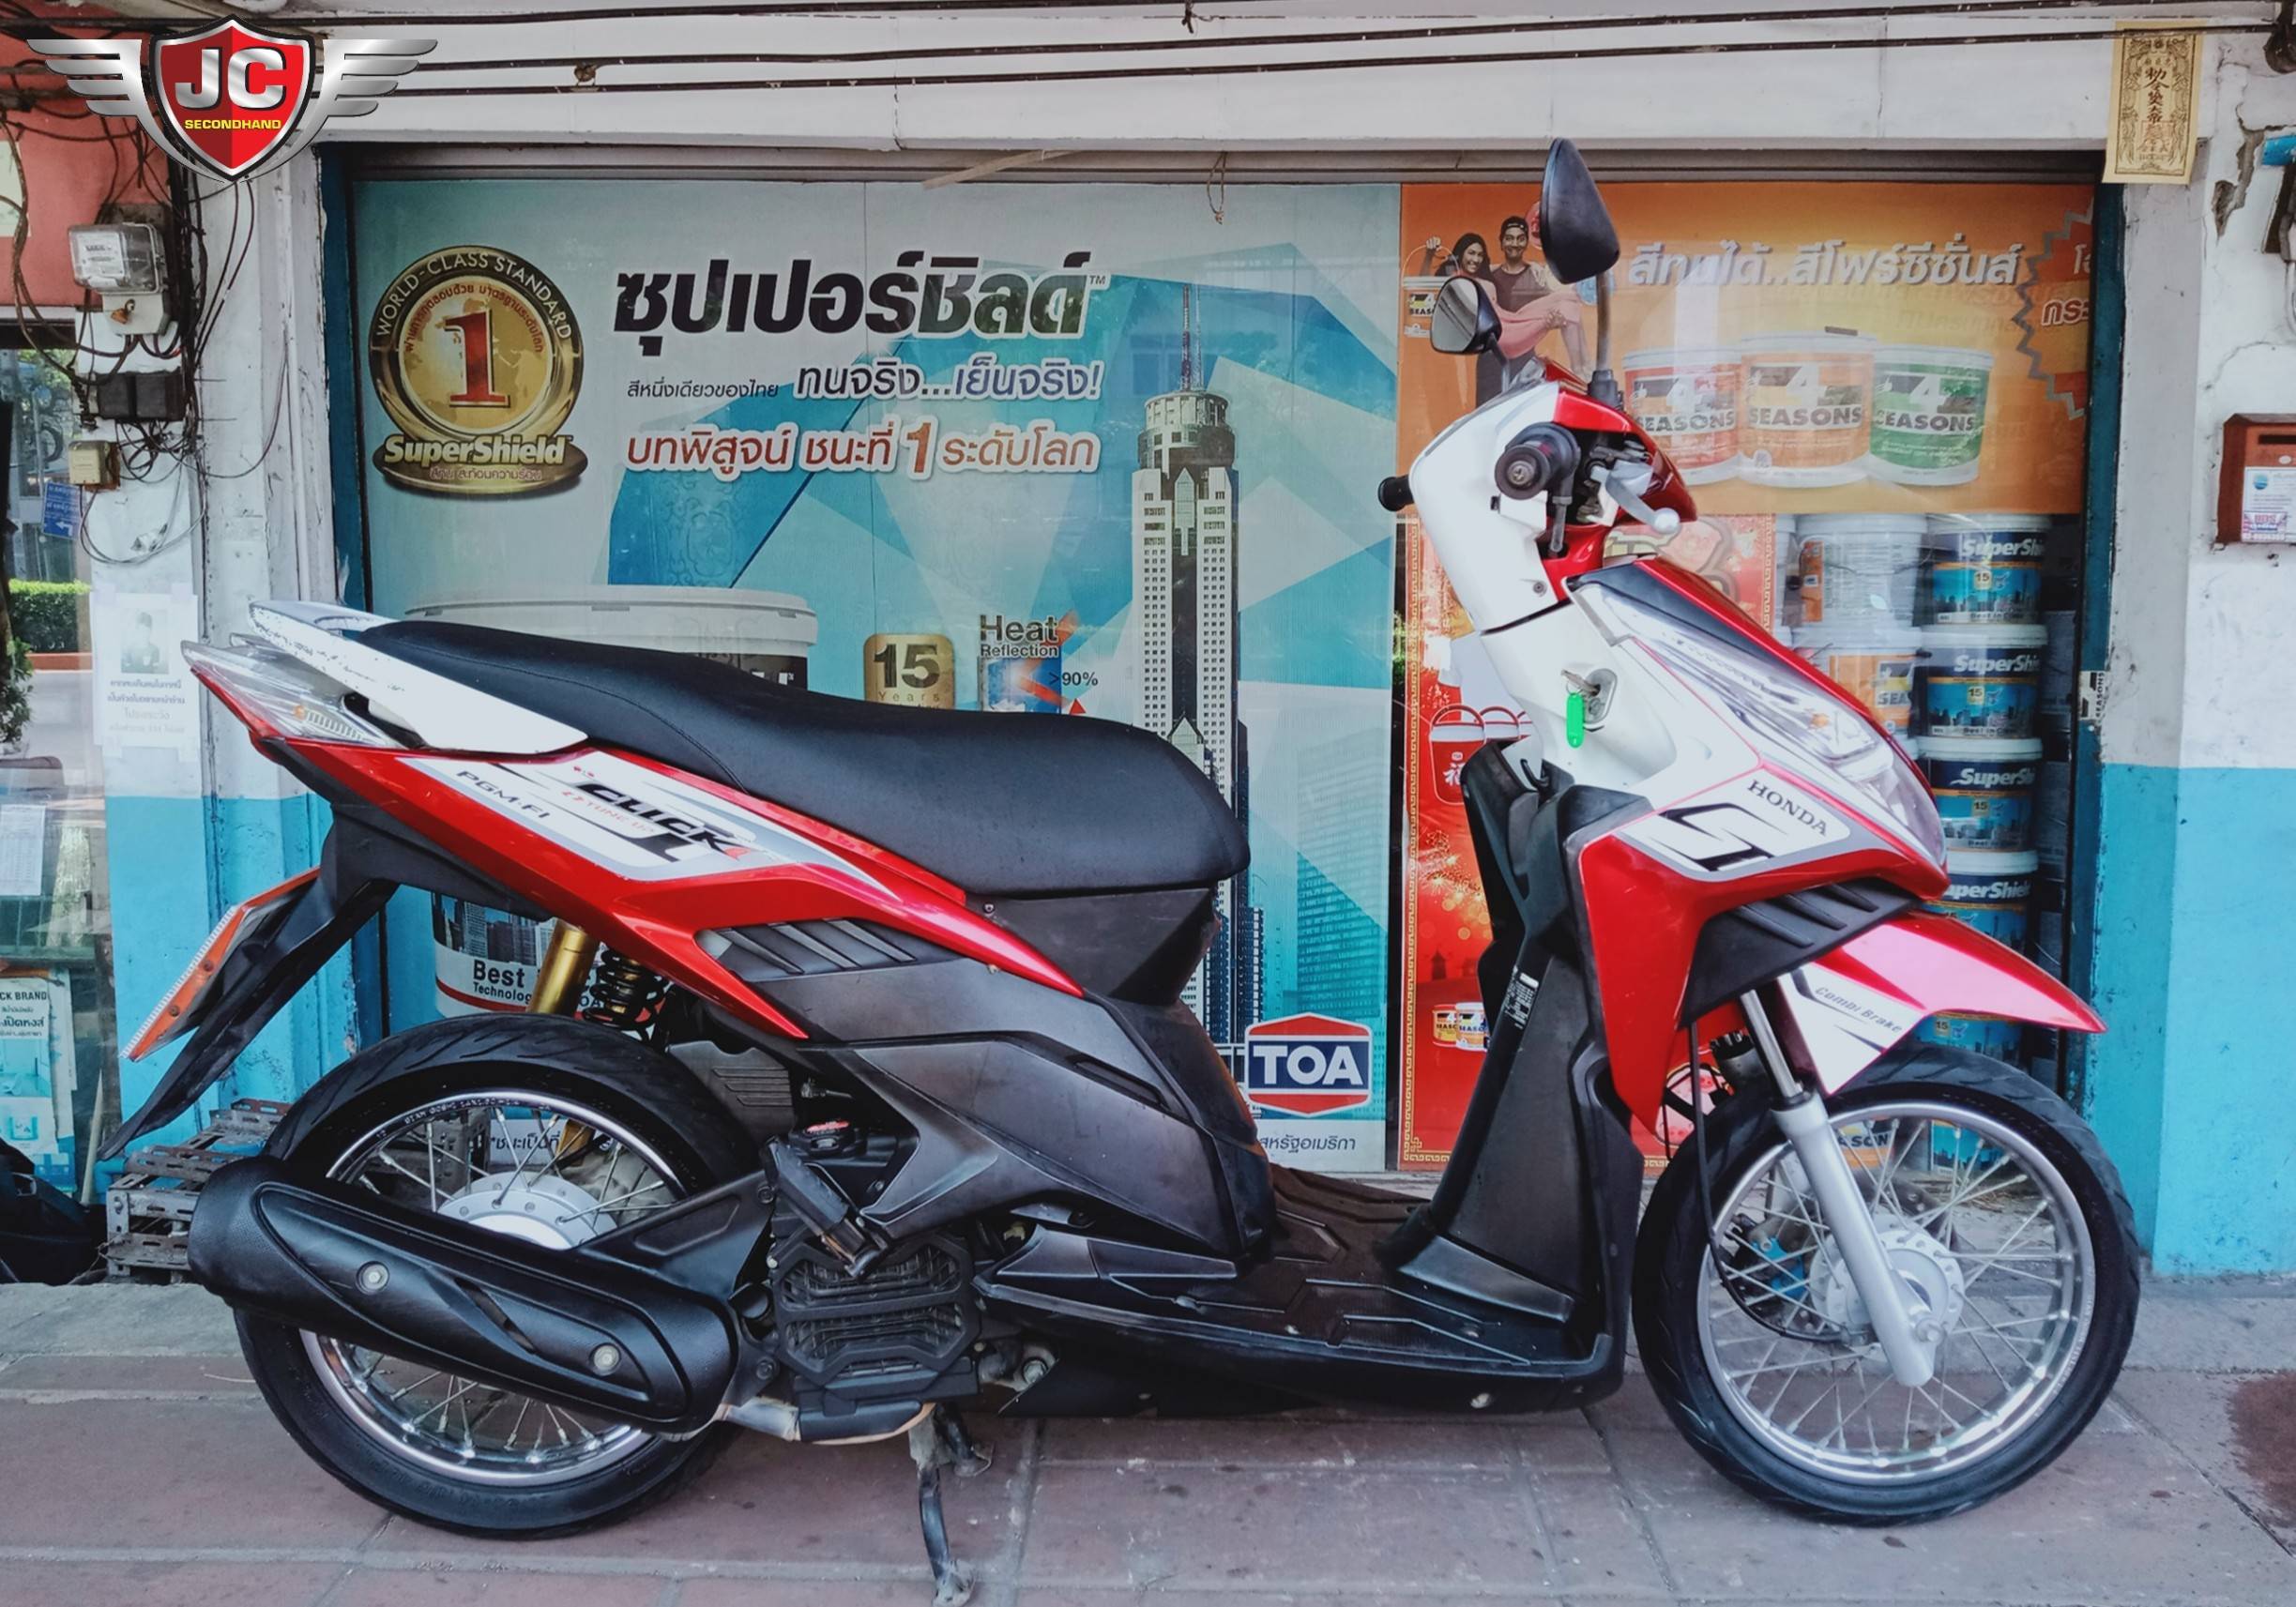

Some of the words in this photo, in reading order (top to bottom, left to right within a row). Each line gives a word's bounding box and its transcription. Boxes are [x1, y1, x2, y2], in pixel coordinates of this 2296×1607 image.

[377, 251, 489, 336] WORLD-CLASS
[494, 255, 572, 340] STANDARD
[445, 310, 508, 405] 1
[627, 376, 779, 398] สีหนึ่งเดียวของไทย
[798, 356, 1102, 396] ทนจริง...เย็นจริง!
[1748, 405, 1863, 428] SEASONS
[384, 434, 566, 466] SuperShield
[628, 429, 792, 475] บทพิสูจน์
[805, 421, 895, 466] ชนะที่
[906, 422, 932, 474] 1
[942, 426, 1094, 466] ระดับโลก
[1975, 573, 1990, 582] 15
[980, 614, 1058, 642] Heat
[980, 644, 1059, 658] Reflection
[874, 644, 940, 689] 15
[1049, 672, 1099, 686] >90%
[878, 691, 940, 702] Years
[1969, 689, 1983, 697] 15
[1747, 780, 1828, 836] HONDA
[473, 960, 525, 988] Best
[0, 992, 12, 1001] CK
[15, 991, 47, 1001] BRAND
[473, 981, 532, 1005] Technolog
[1862, 1008, 1903, 1033] Brake
[1253, 1045, 1363, 1085] TOA
